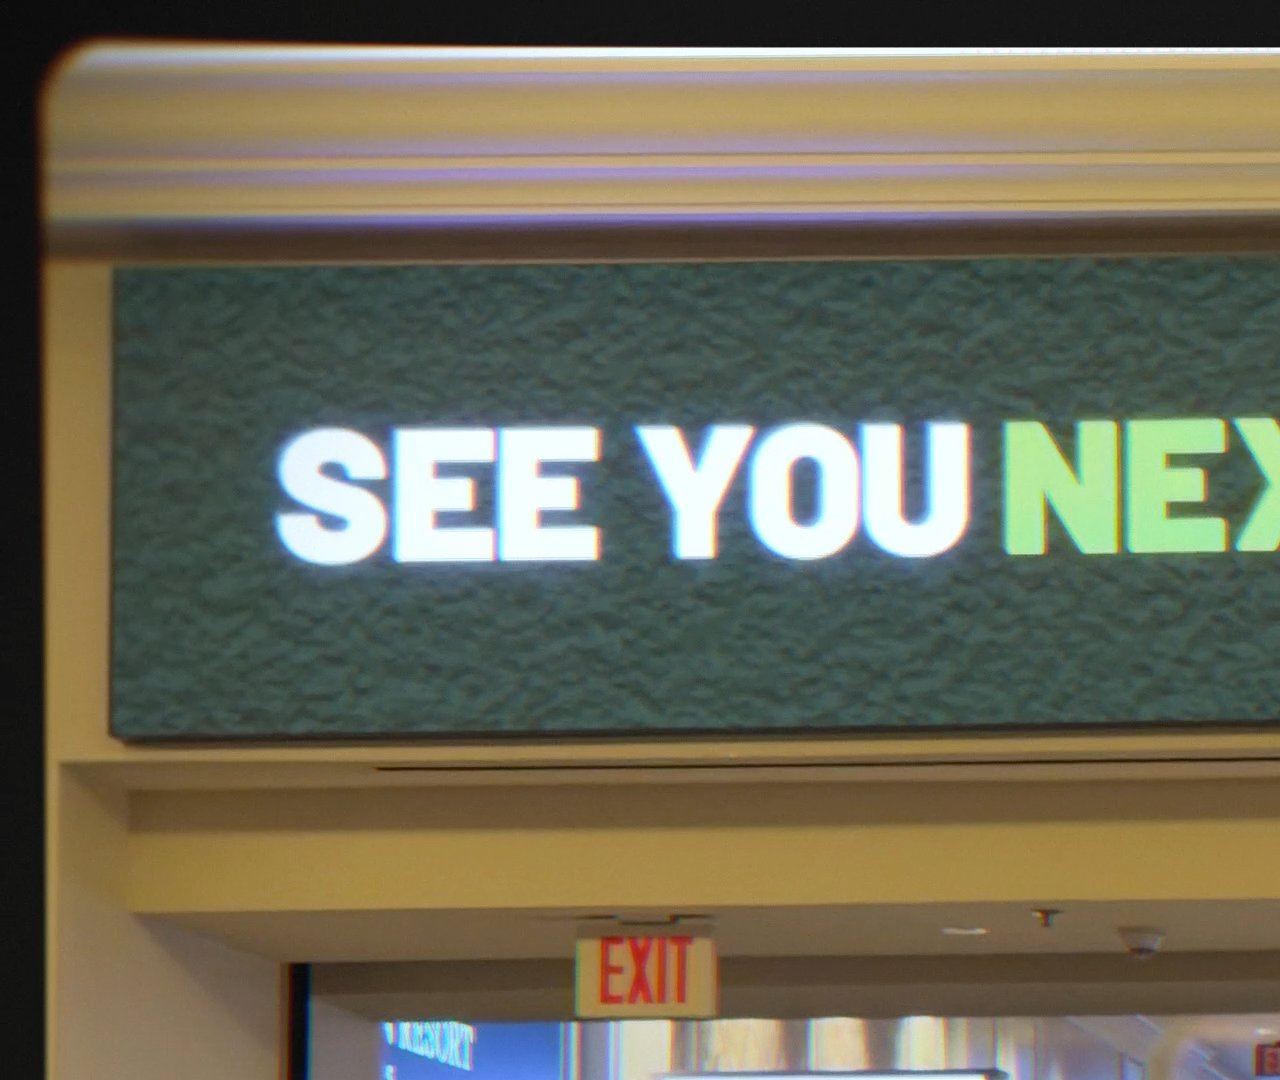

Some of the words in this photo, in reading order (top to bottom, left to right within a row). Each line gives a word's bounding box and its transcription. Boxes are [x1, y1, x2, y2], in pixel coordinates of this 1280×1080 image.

[275, 426, 602, 567] SEE
[633, 422, 971, 561] YOU
[599, 936, 694, 1004] EXIT
